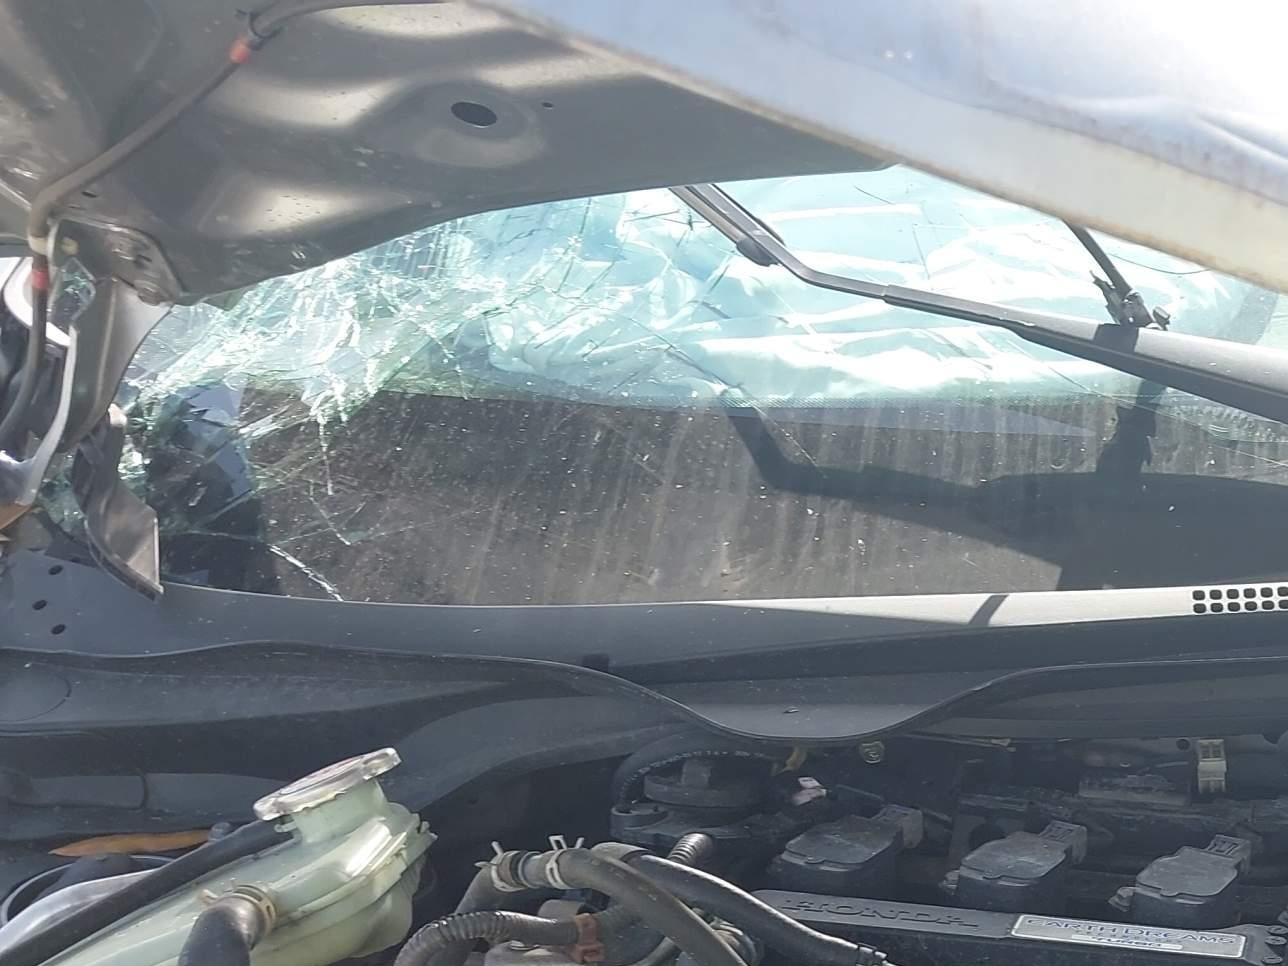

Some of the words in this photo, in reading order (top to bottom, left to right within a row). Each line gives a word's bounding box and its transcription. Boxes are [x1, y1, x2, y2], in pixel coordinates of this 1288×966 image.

[781, 899, 979, 928] HONDA
[1027, 917, 1117, 933] EARTH
[1124, 926, 1236, 944] DREAMS
